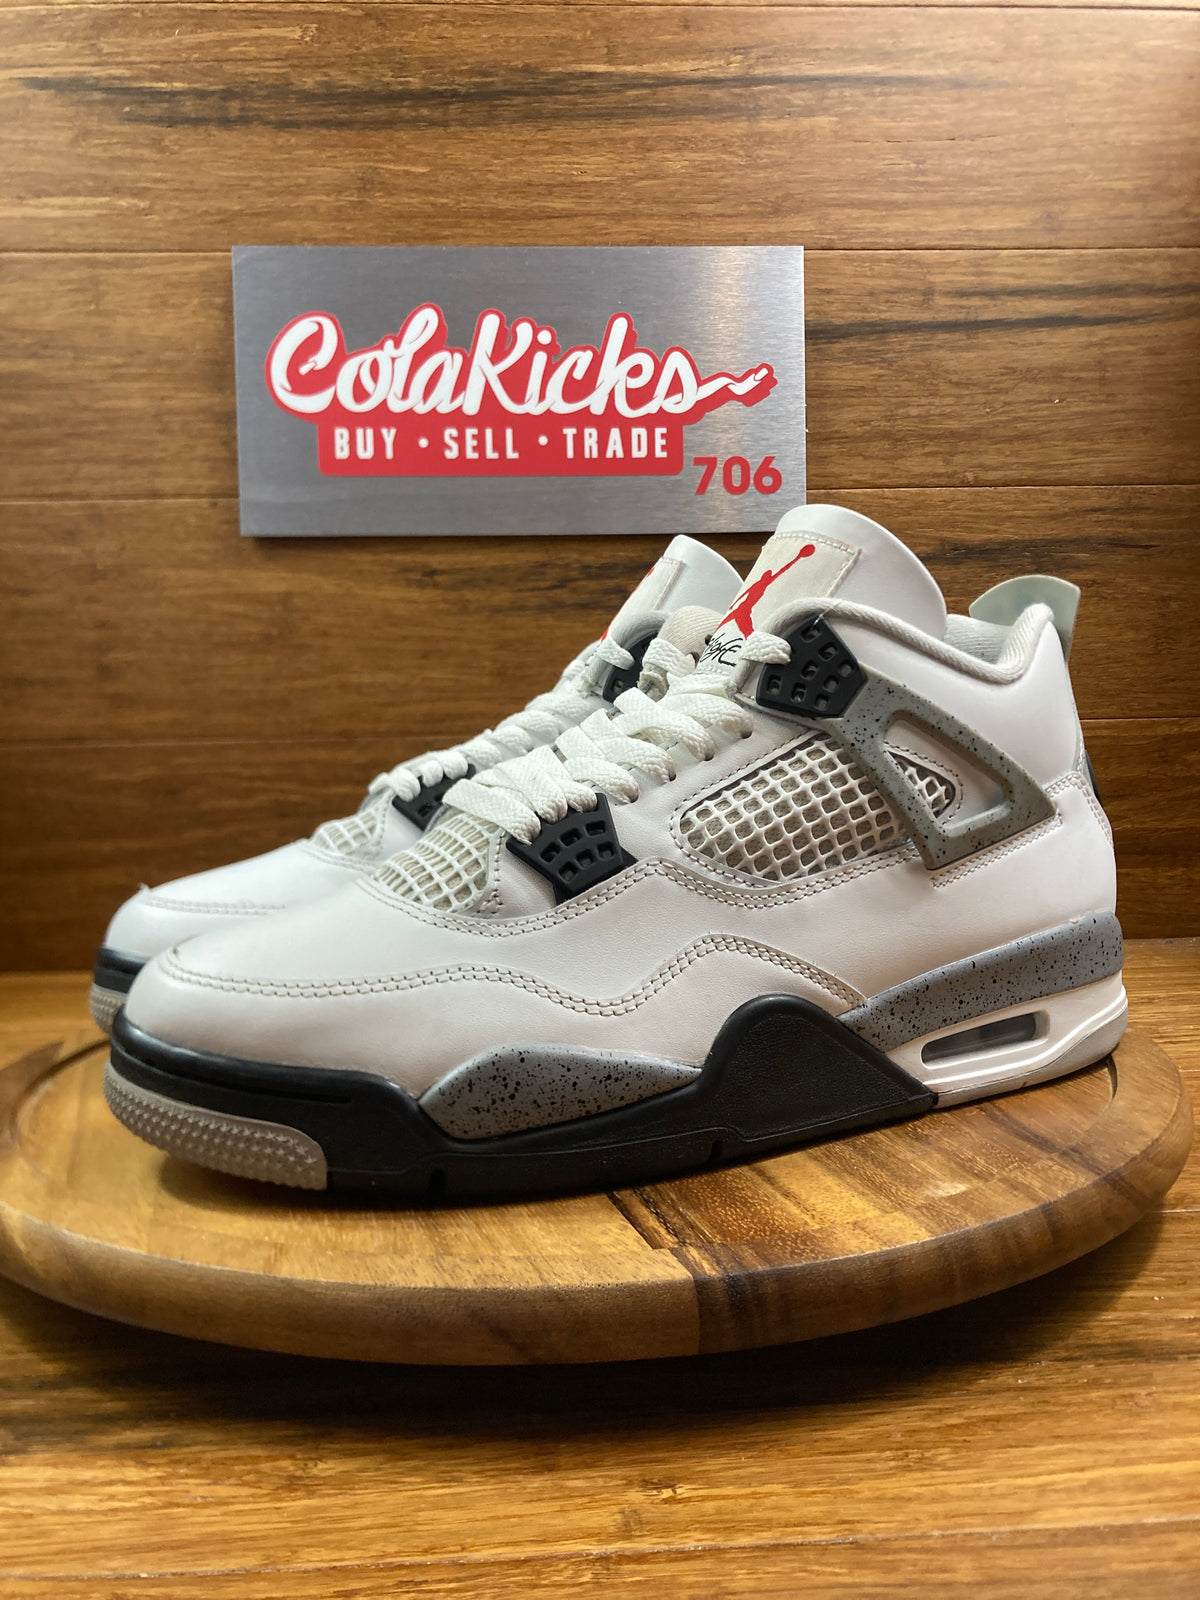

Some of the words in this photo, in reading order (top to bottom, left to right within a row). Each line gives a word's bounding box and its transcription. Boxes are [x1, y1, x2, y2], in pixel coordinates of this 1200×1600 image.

[269, 305, 769, 418] ColaKicks
[334, 427, 398, 459] BUY
[444, 427, 520, 459] SELL
[563, 427, 669, 459] TRADE
[693, 456, 783, 496] 706
